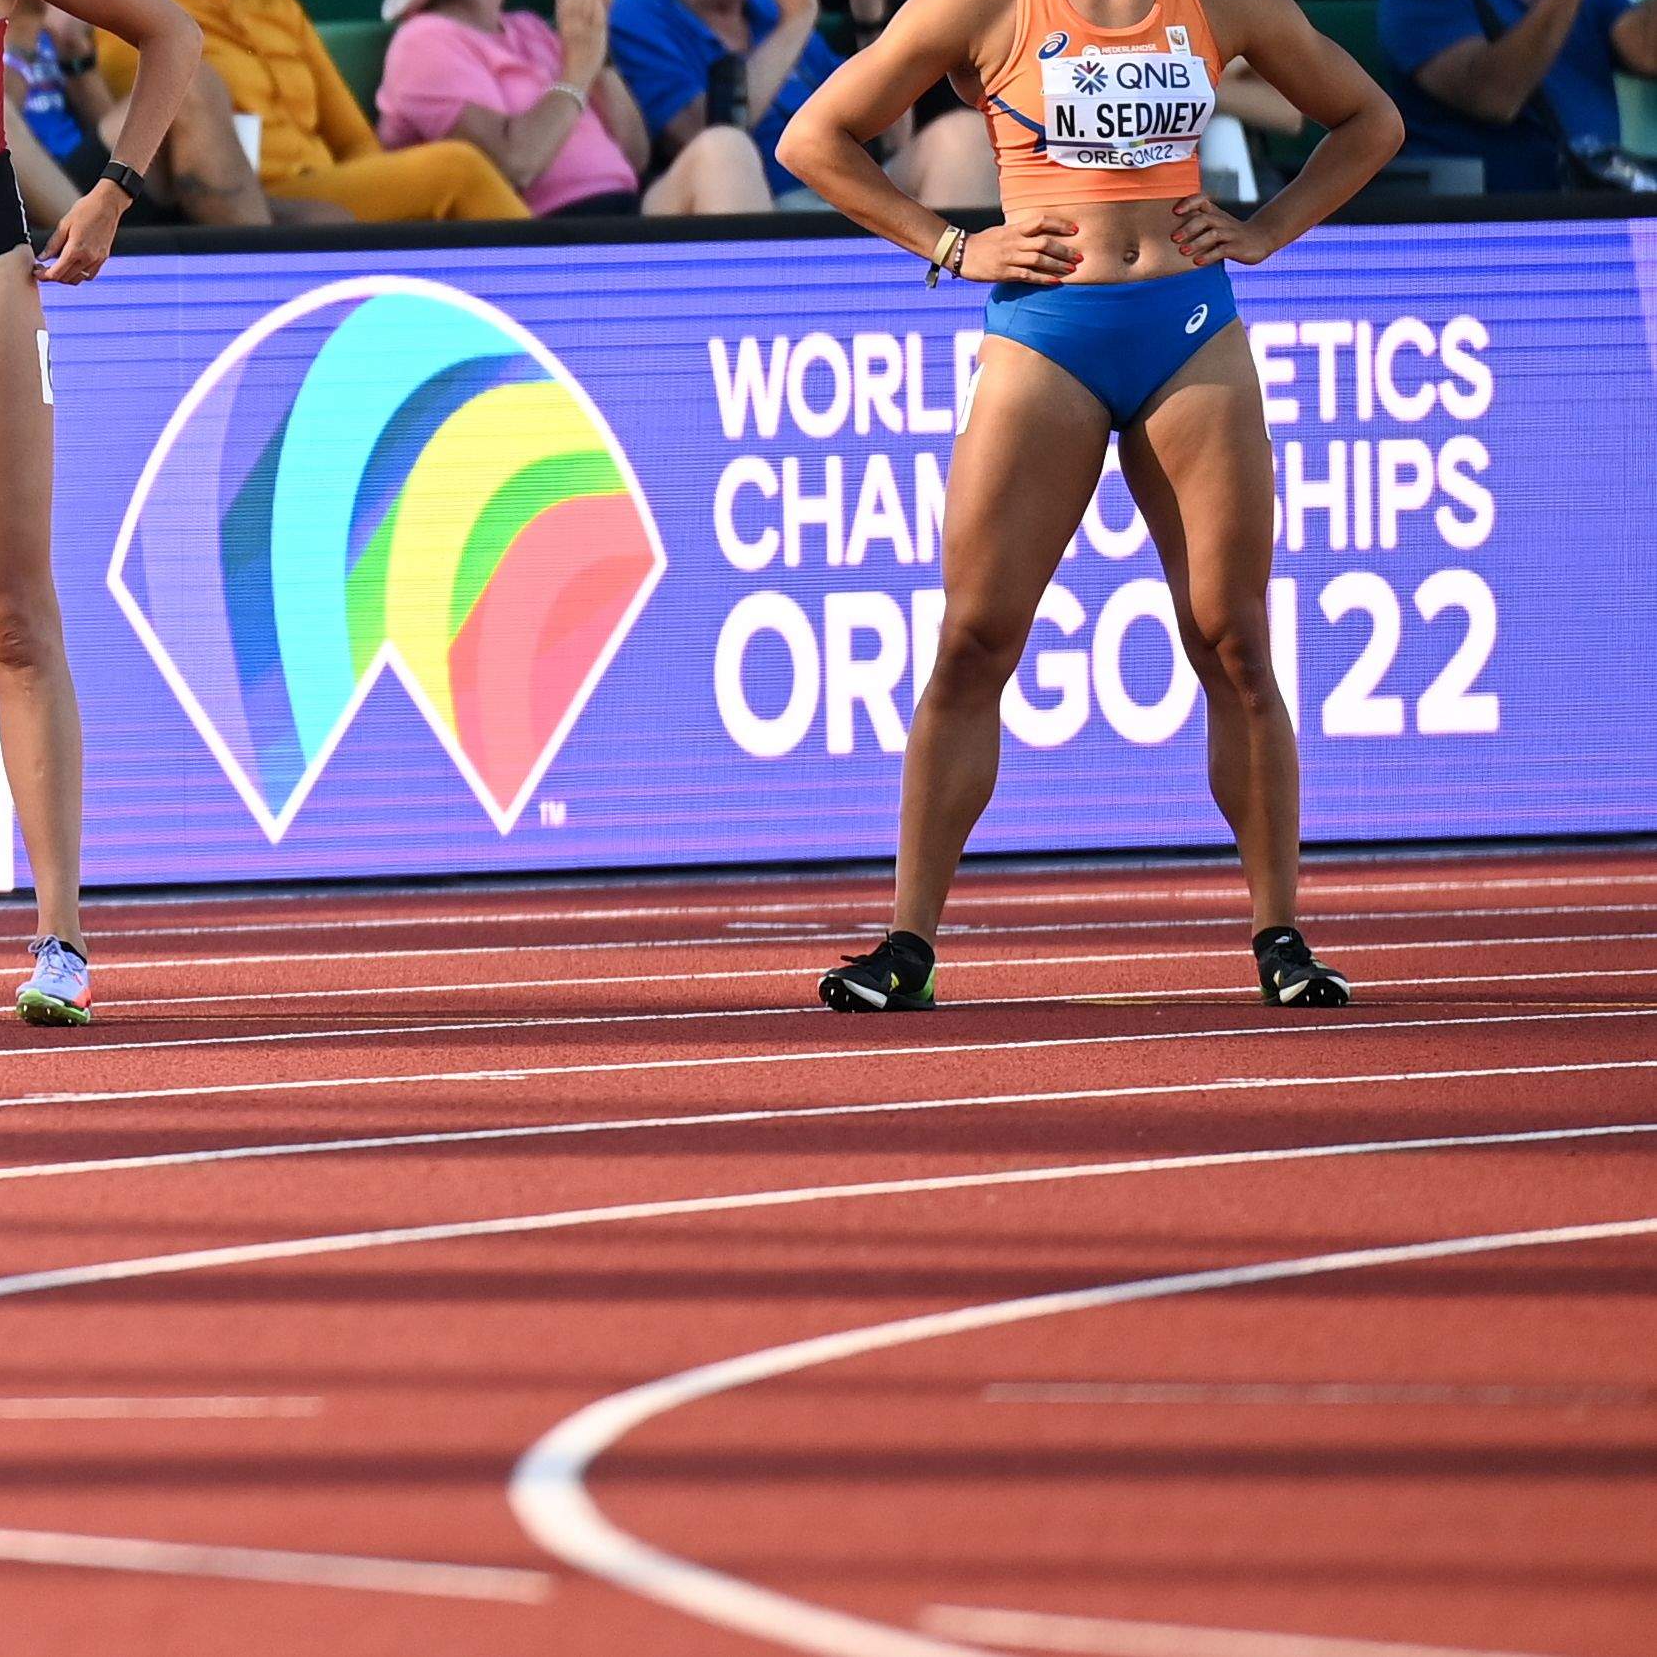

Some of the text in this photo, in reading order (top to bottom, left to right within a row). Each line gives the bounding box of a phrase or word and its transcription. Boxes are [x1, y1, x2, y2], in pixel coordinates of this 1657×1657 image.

[1116, 62, 1191, 90] QNB
[1056, 102, 1208, 139] N. SEDNEY
[1077, 143, 1174, 167] OREGON22
[1248, 315, 1495, 424] ETICS
[713, 435, 1497, 572] CHAOHIPS
